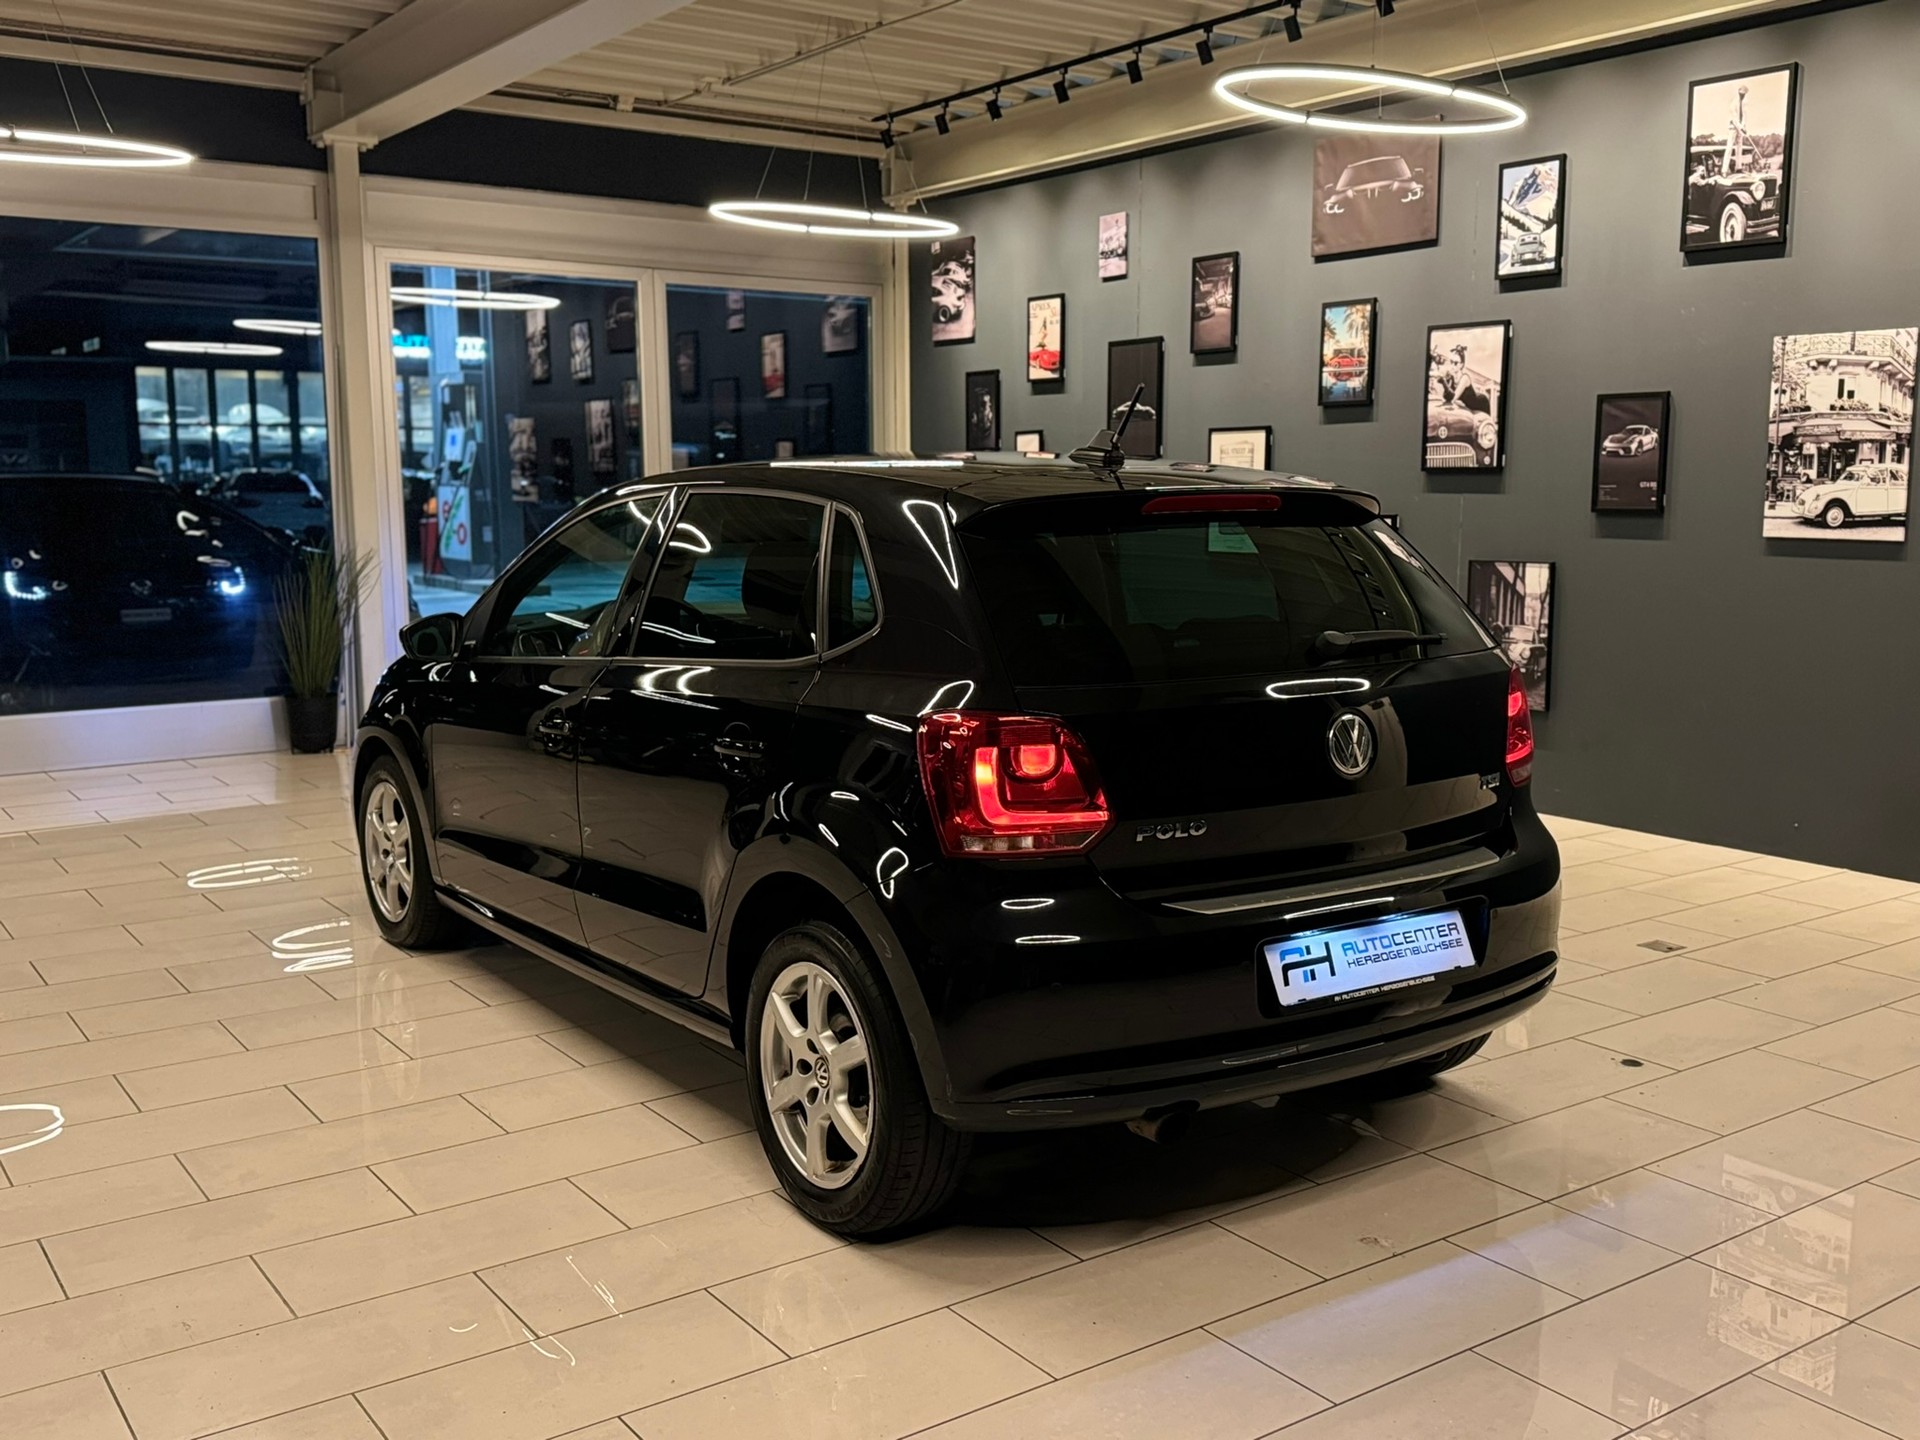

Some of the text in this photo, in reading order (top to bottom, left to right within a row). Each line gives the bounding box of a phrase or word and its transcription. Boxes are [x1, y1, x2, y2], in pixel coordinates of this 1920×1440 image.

[1136, 819, 1207, 842] POLO
[1341, 922, 1460, 957] AUTOCENTER
[1346, 937, 1464, 969] HERZOGENBUCHSEE
